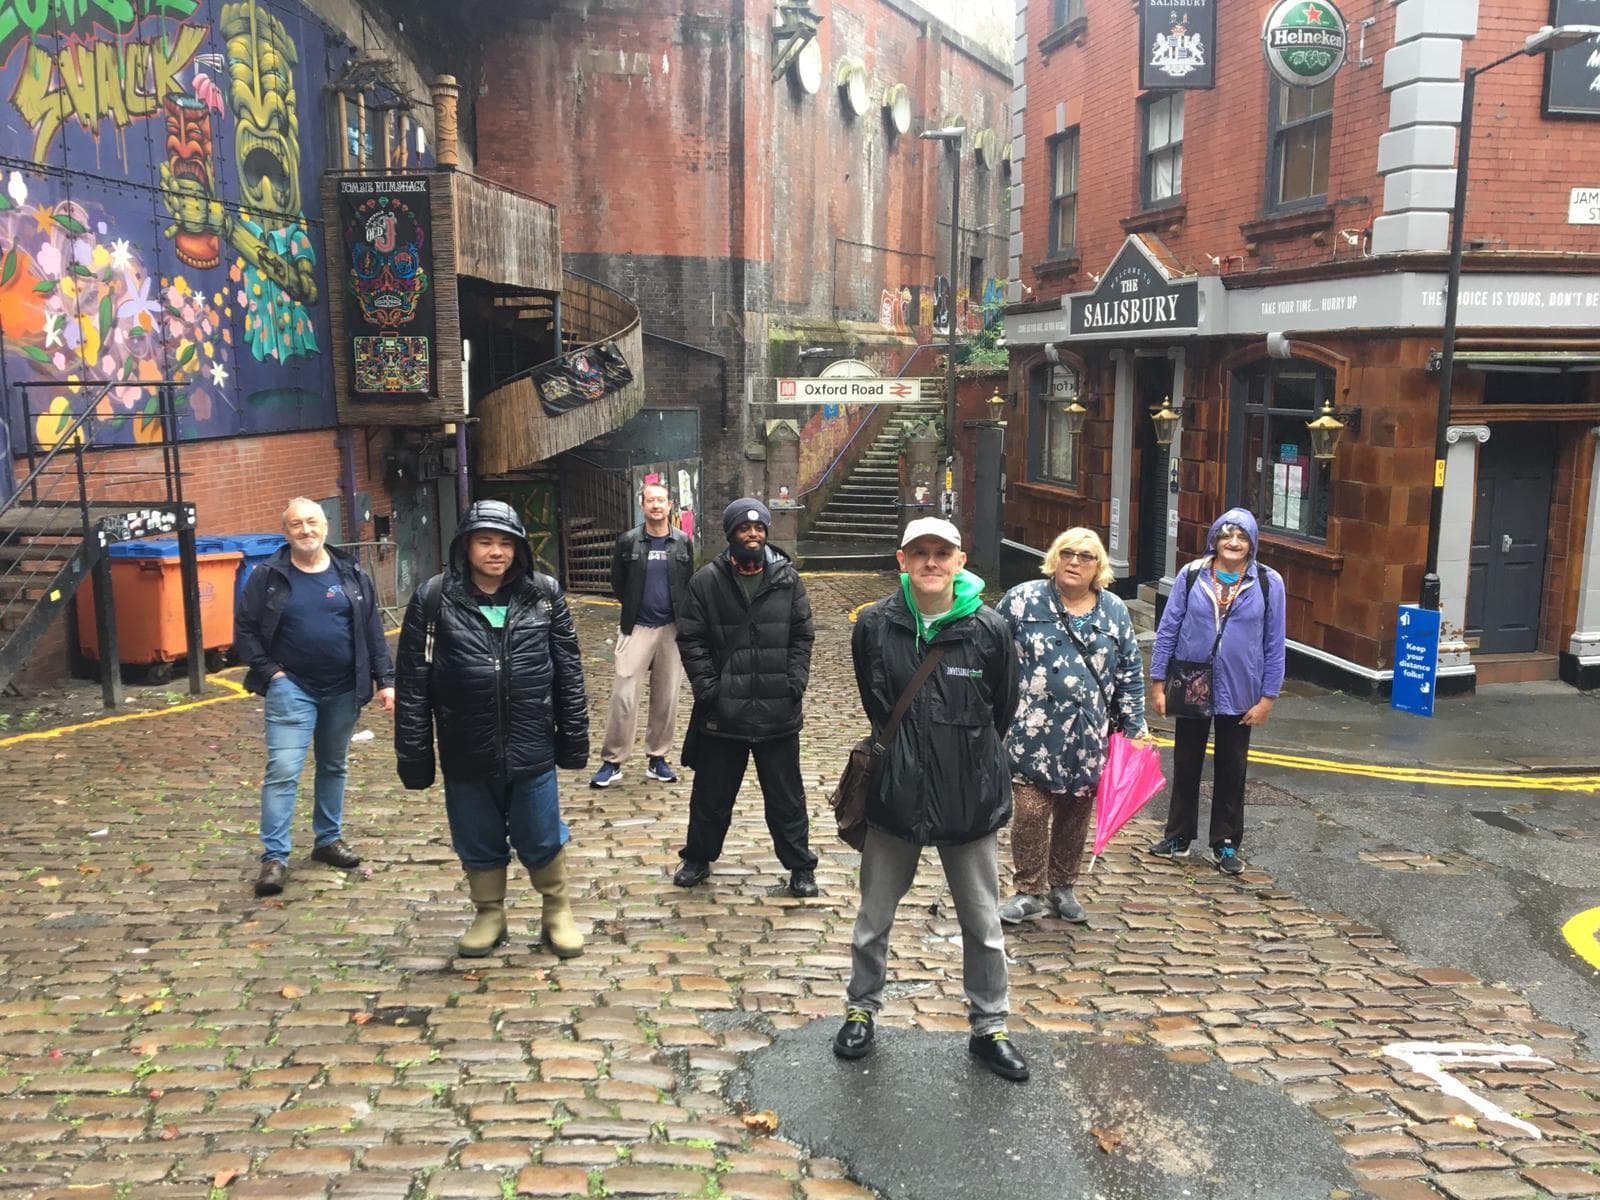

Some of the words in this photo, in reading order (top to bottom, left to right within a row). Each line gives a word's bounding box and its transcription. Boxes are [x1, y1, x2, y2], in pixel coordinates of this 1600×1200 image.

[1274, 29, 1343, 48] Heineken
[341, 182, 374, 193] ZOMBIE
[375, 180, 426, 192] RUMSHACK
[1120, 279, 1139, 293] THE
[1261, 302, 1276, 315] TAKE
[1278, 301, 1294, 314] YOUR
[1321, 296, 1346, 312] HURRY
[1347, 295, 1358, 310] UP
[1421, 291, 1443, 306] THE
[1492, 291, 1504, 306] IS
[1506, 291, 1545, 308] YOURS,
[1549, 292, 1582, 306] DON'T
[1585, 293, 1600, 307] BE
[1084, 294, 1180, 328] SALISBURY
[804, 384, 848, 396] Oxford
[851, 384, 884, 396] Road
[1406, 642, 1425, 653] Keep
[1407, 653, 1424, 661] your
[1399, 660, 1431, 671] distance
[1403, 669, 1424, 679] folks!
